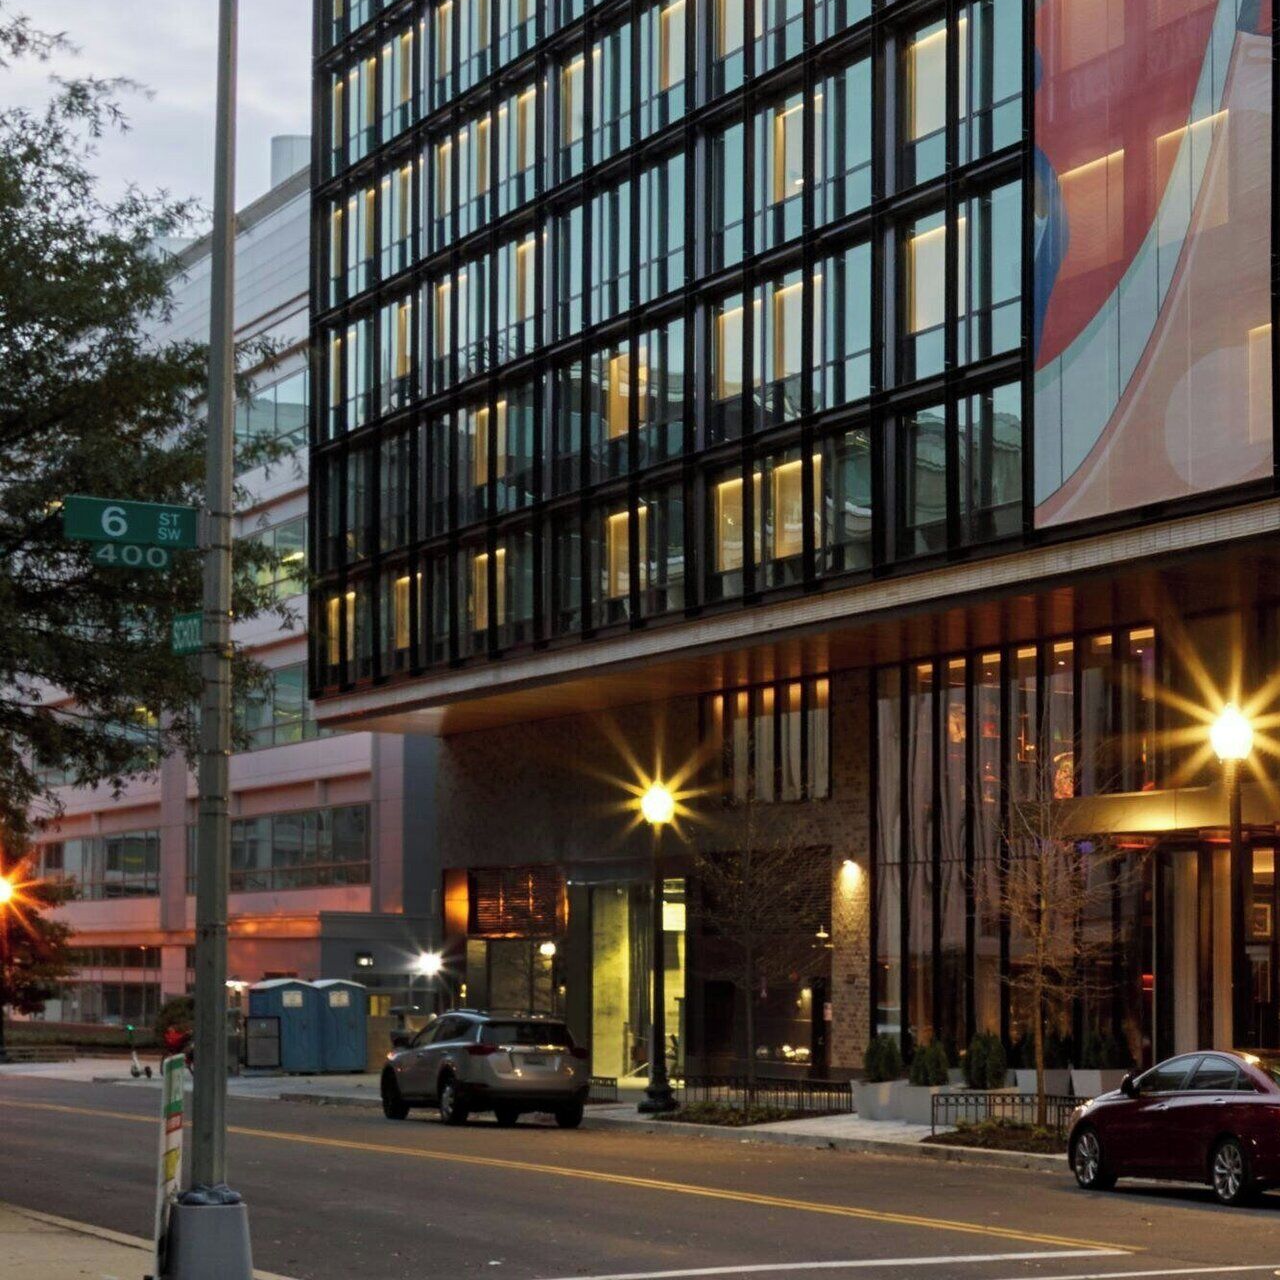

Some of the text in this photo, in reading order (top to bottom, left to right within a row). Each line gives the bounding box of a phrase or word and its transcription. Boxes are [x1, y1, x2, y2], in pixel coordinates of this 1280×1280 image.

[101, 506, 128, 537] 6
[159, 512, 180, 526] ST
[158, 527, 181, 540] SW
[96, 543, 168, 567] 400
